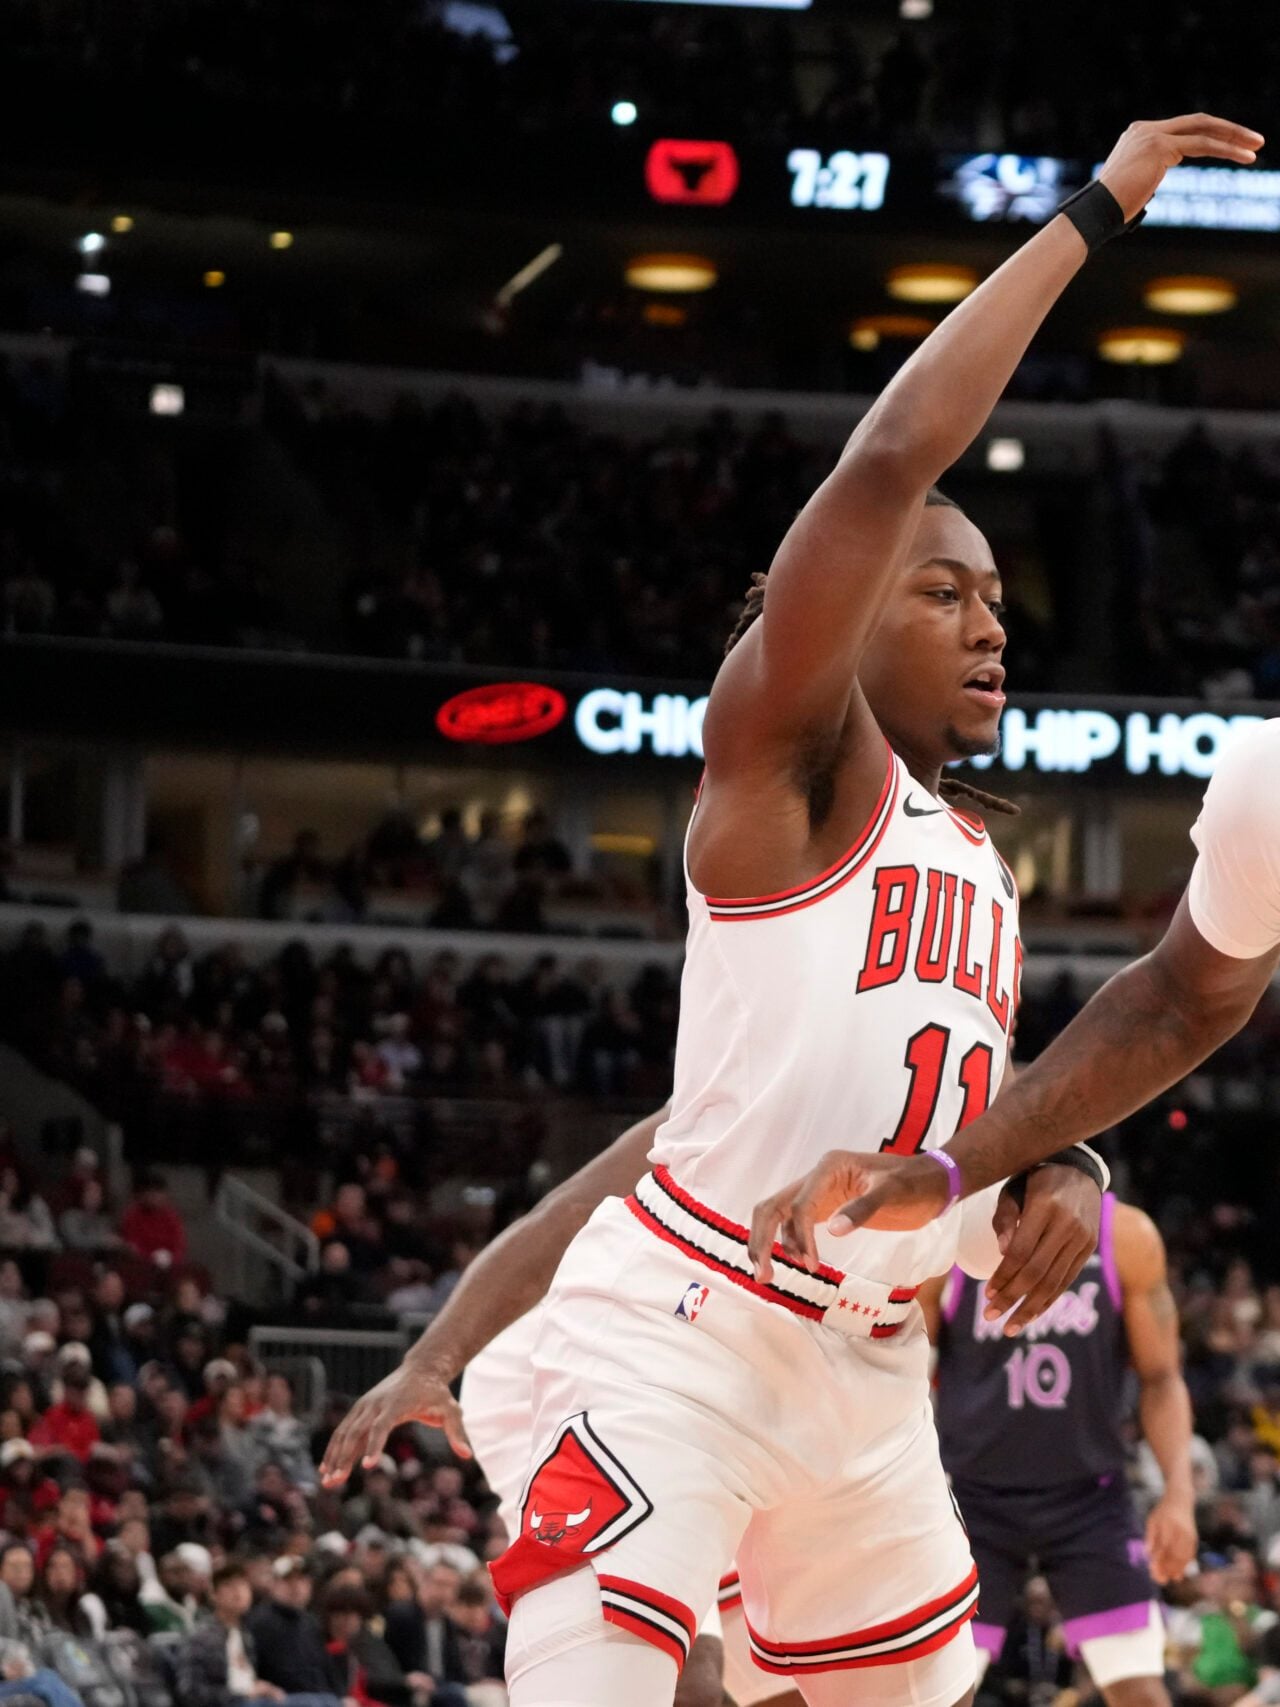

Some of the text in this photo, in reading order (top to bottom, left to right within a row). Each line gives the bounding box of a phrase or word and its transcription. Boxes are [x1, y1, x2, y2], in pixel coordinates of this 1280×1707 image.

[787, 148, 890, 210] 7:27
[1003, 708, 1122, 772] HIP
[879, 1021, 993, 1156] 11
[1004, 1343, 1072, 1409] 10
